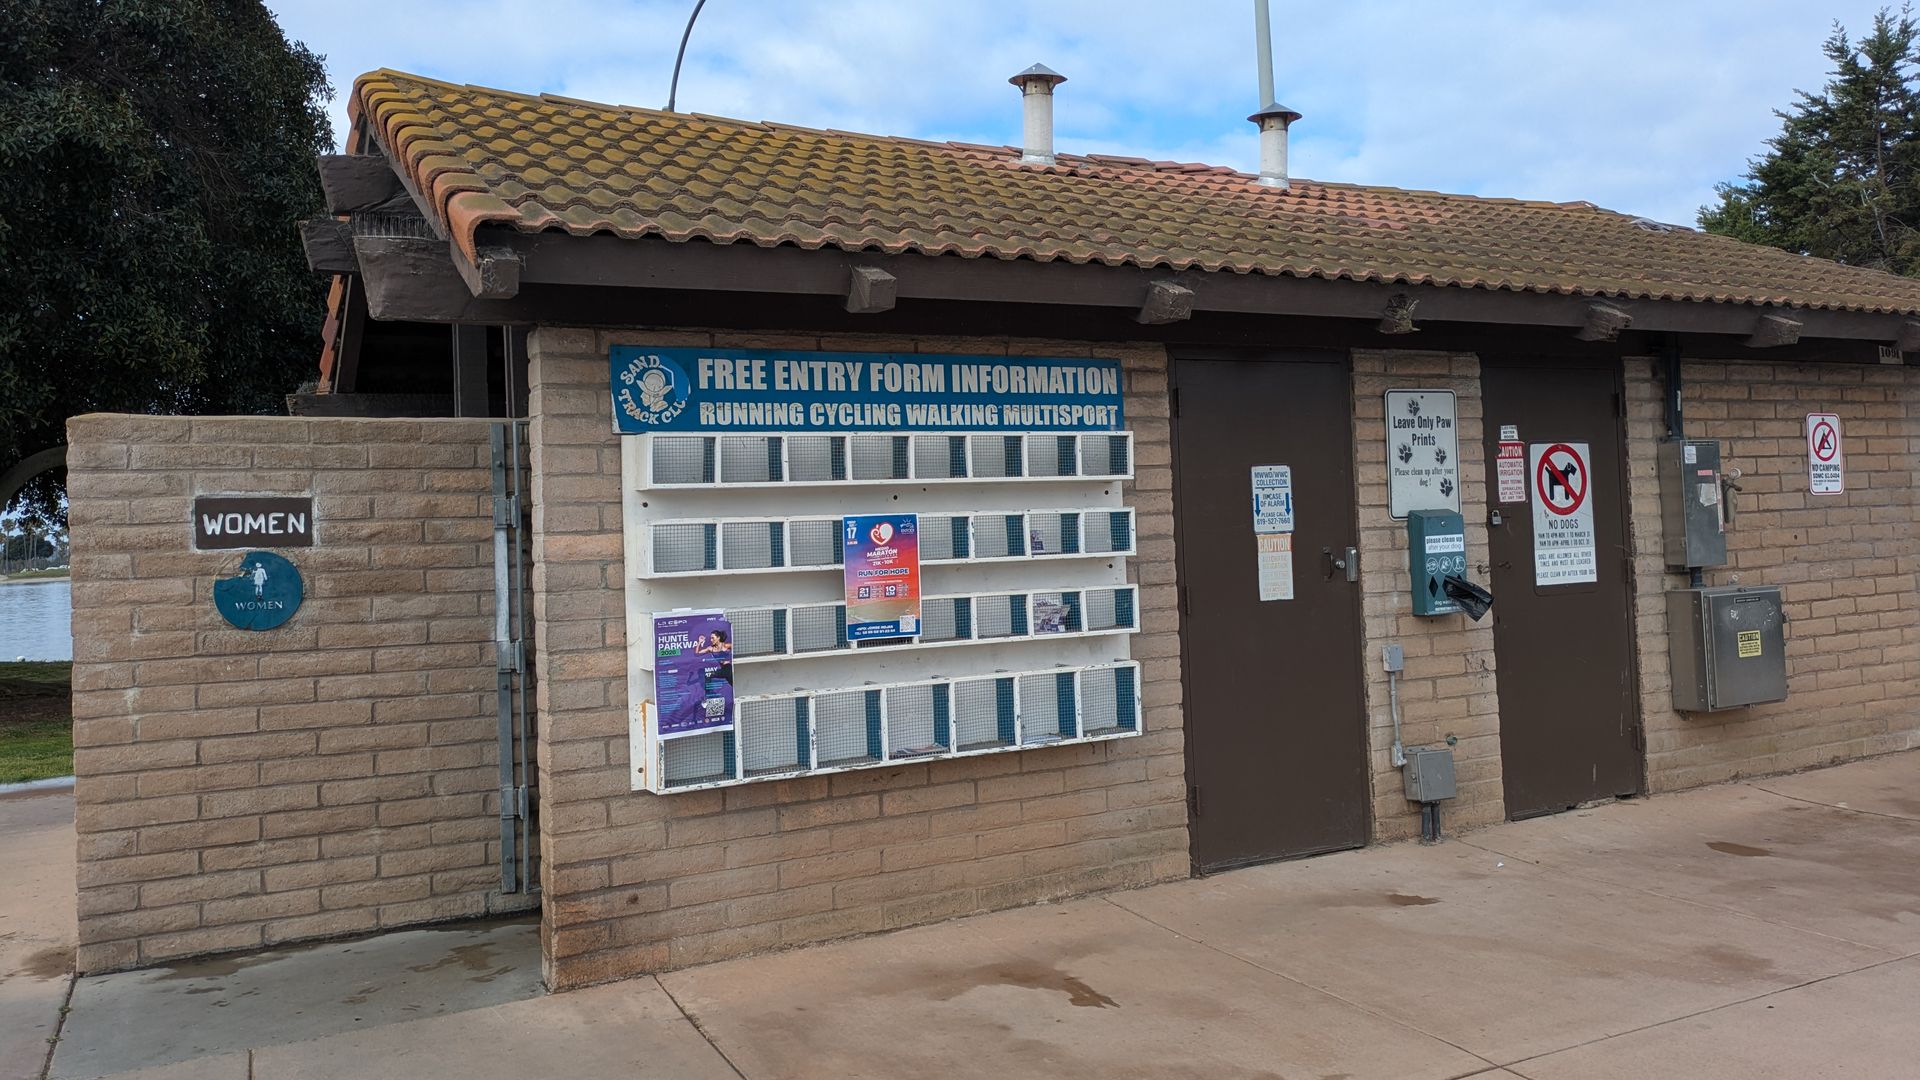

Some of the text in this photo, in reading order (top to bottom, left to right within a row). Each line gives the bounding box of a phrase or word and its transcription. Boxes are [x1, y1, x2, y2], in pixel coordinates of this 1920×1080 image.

[698, 358, 1118, 394] FREE ENTRY FORM INFORMATION
[618, 388, 659, 424] TRACK
[700, 402, 1118, 426] RUNNING CYCLING WALKING MULTISPORT
[1393, 416, 1451, 430] Leave Only Paw
[1412, 434, 1436, 446] Prints
[1394, 468, 1410, 476] Please
[1411, 467, 1423, 476] clean
[1425, 468, 1430, 476] up
[202, 512, 305, 535] WOMEN
[1549, 519, 1578, 530] NO DOGS
[847, 527, 857, 539] 17
[1259, 538, 1291, 551] CAUTION
[235, 601, 283, 610] WOMEN
[658, 634, 688, 644] HUNTE
[658, 640, 705, 650] PARKWAY
